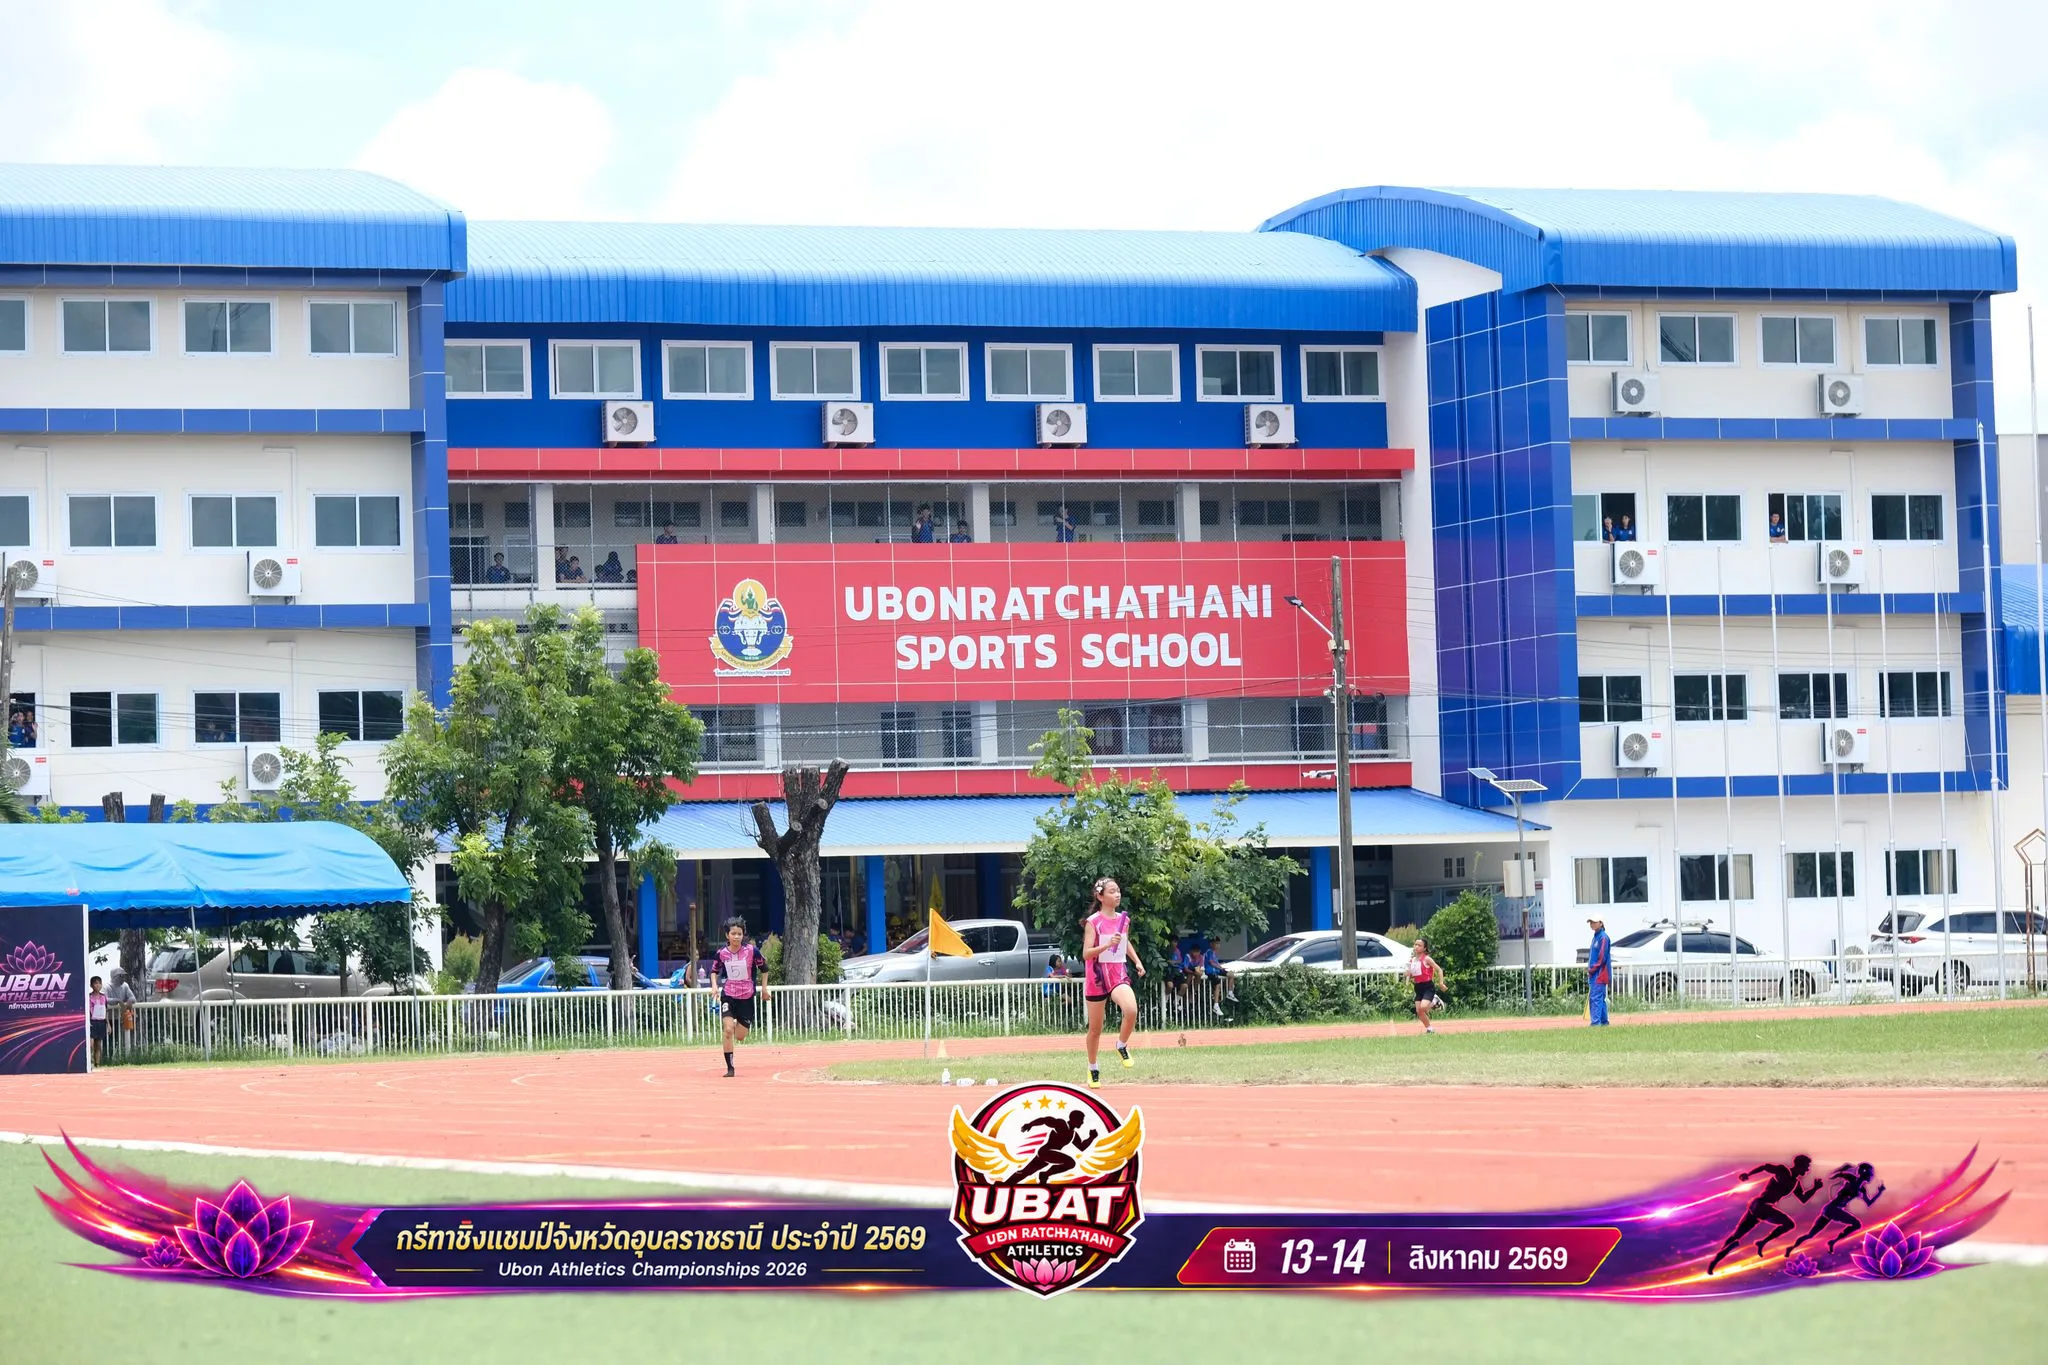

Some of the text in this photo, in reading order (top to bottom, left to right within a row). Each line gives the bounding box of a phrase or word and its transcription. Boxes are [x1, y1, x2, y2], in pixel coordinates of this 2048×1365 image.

[844, 584, 1273, 621] UBONRATCHATHANI
[896, 632, 1242, 671] SPORTS SCHOOL
[731, 965, 740, 978] 5
[0, 973, 71, 992] UBON
[0, 991, 67, 1001] ATHLETICS
